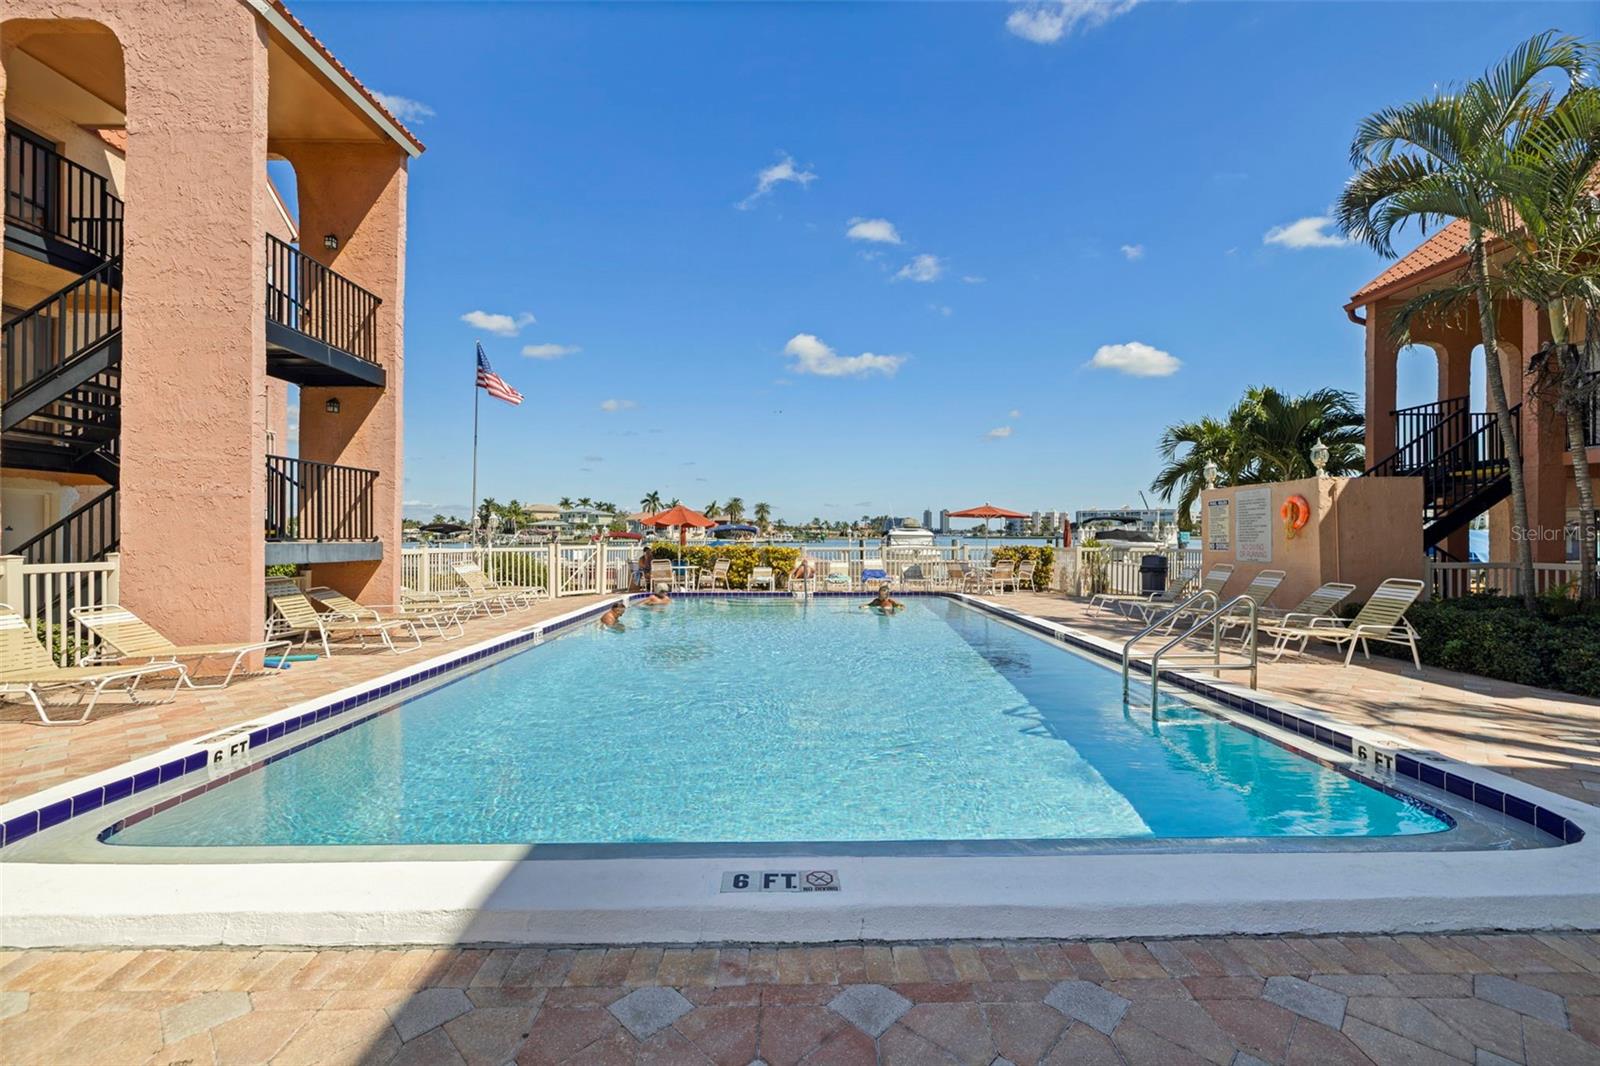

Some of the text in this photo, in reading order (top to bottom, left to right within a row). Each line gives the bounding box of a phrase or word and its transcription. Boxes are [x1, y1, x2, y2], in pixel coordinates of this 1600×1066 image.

[213, 740, 248, 763] 6 FT
[1358, 745, 1393, 769] 6 FT
[733, 873, 797, 889] 6 FT.
